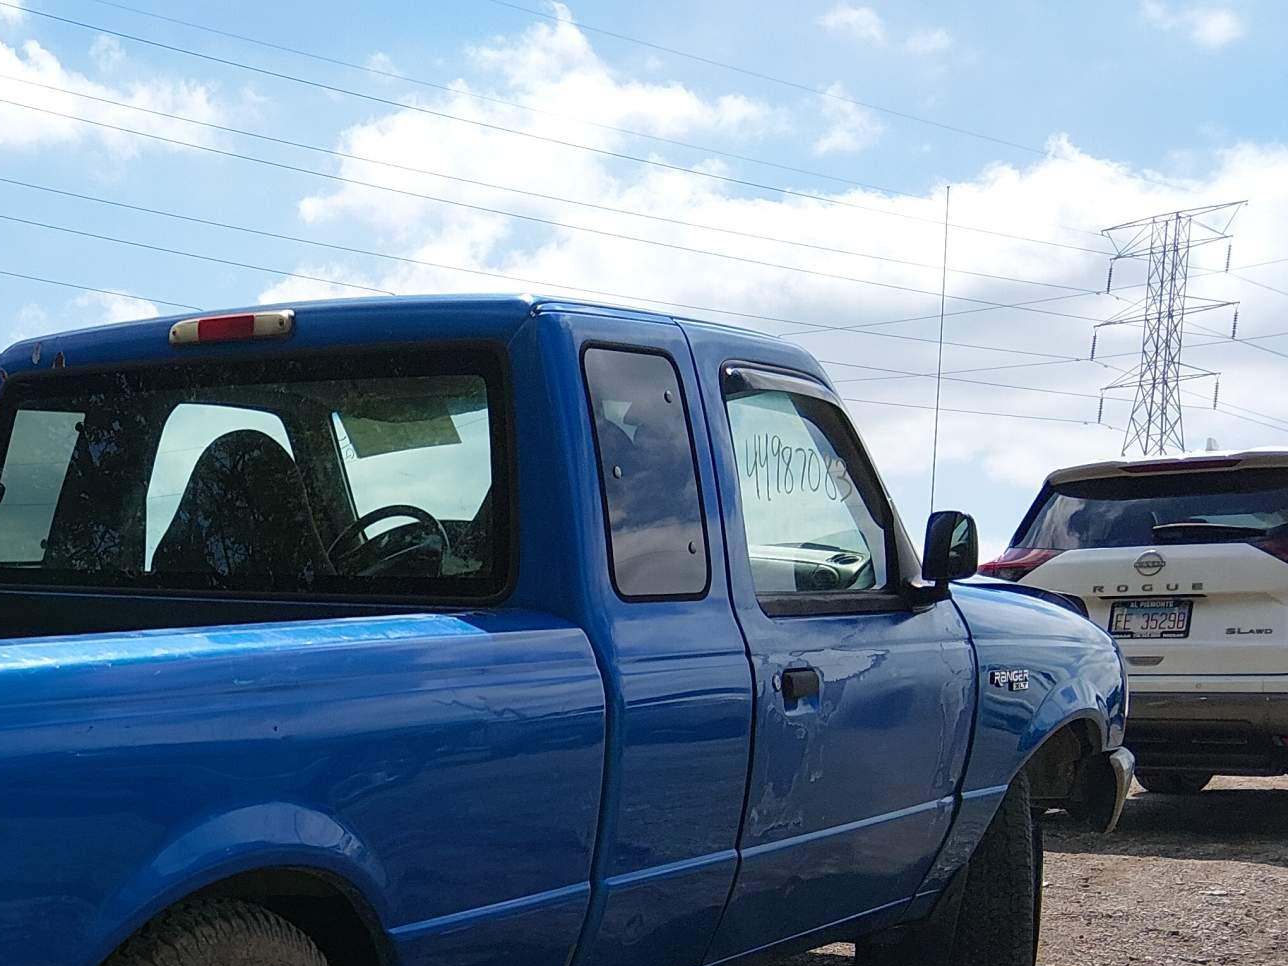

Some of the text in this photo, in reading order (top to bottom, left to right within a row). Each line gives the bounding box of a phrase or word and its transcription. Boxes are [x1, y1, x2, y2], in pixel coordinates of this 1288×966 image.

[745, 432, 853, 502] 44987083
[1092, 582, 1204, 593] ROGUE
[994, 669, 1029, 687] RANGER
